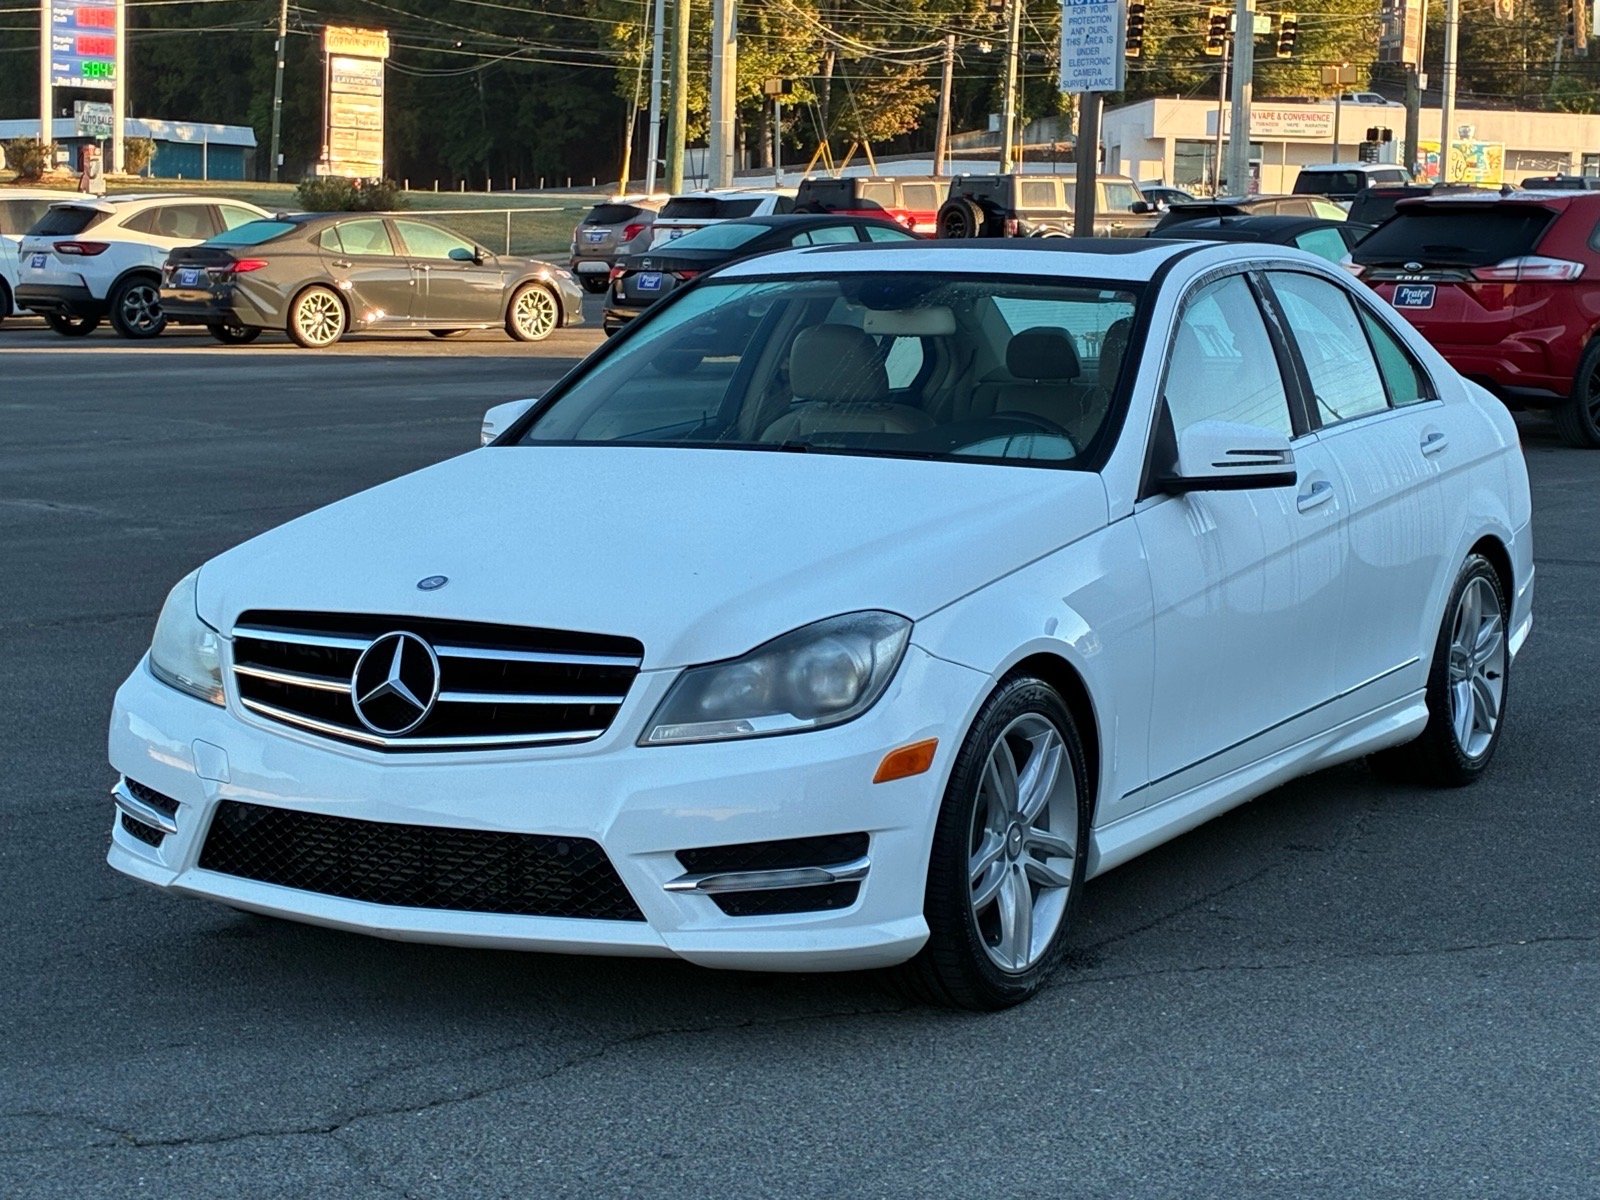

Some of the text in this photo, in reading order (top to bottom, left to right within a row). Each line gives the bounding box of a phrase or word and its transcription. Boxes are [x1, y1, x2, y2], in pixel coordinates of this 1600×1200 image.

[1072, 4, 1109, 15] FOR YOUR
[1068, 16, 1112, 25] PROTECTION
[1071, 27, 1086, 36] AND
[1066, 35, 1114, 47] THIS AREA IS
[1077, 47, 1100, 56] UNDER
[1068, 57, 1111, 67] ELECTRONIC
[1073, 68, 1102, 77] CAMERA
[1063, 77, 1114, 88] SURVEILLANCE
[80, 112, 97, 124] AUTO
[1258, 112, 1276, 120] VAPE
[1276, 112, 1282, 120] &
[1283, 113, 1331, 122] CONVENIENCE
[1401, 288, 1430, 298] Prater
[1405, 296, 1423, 305] Ford
